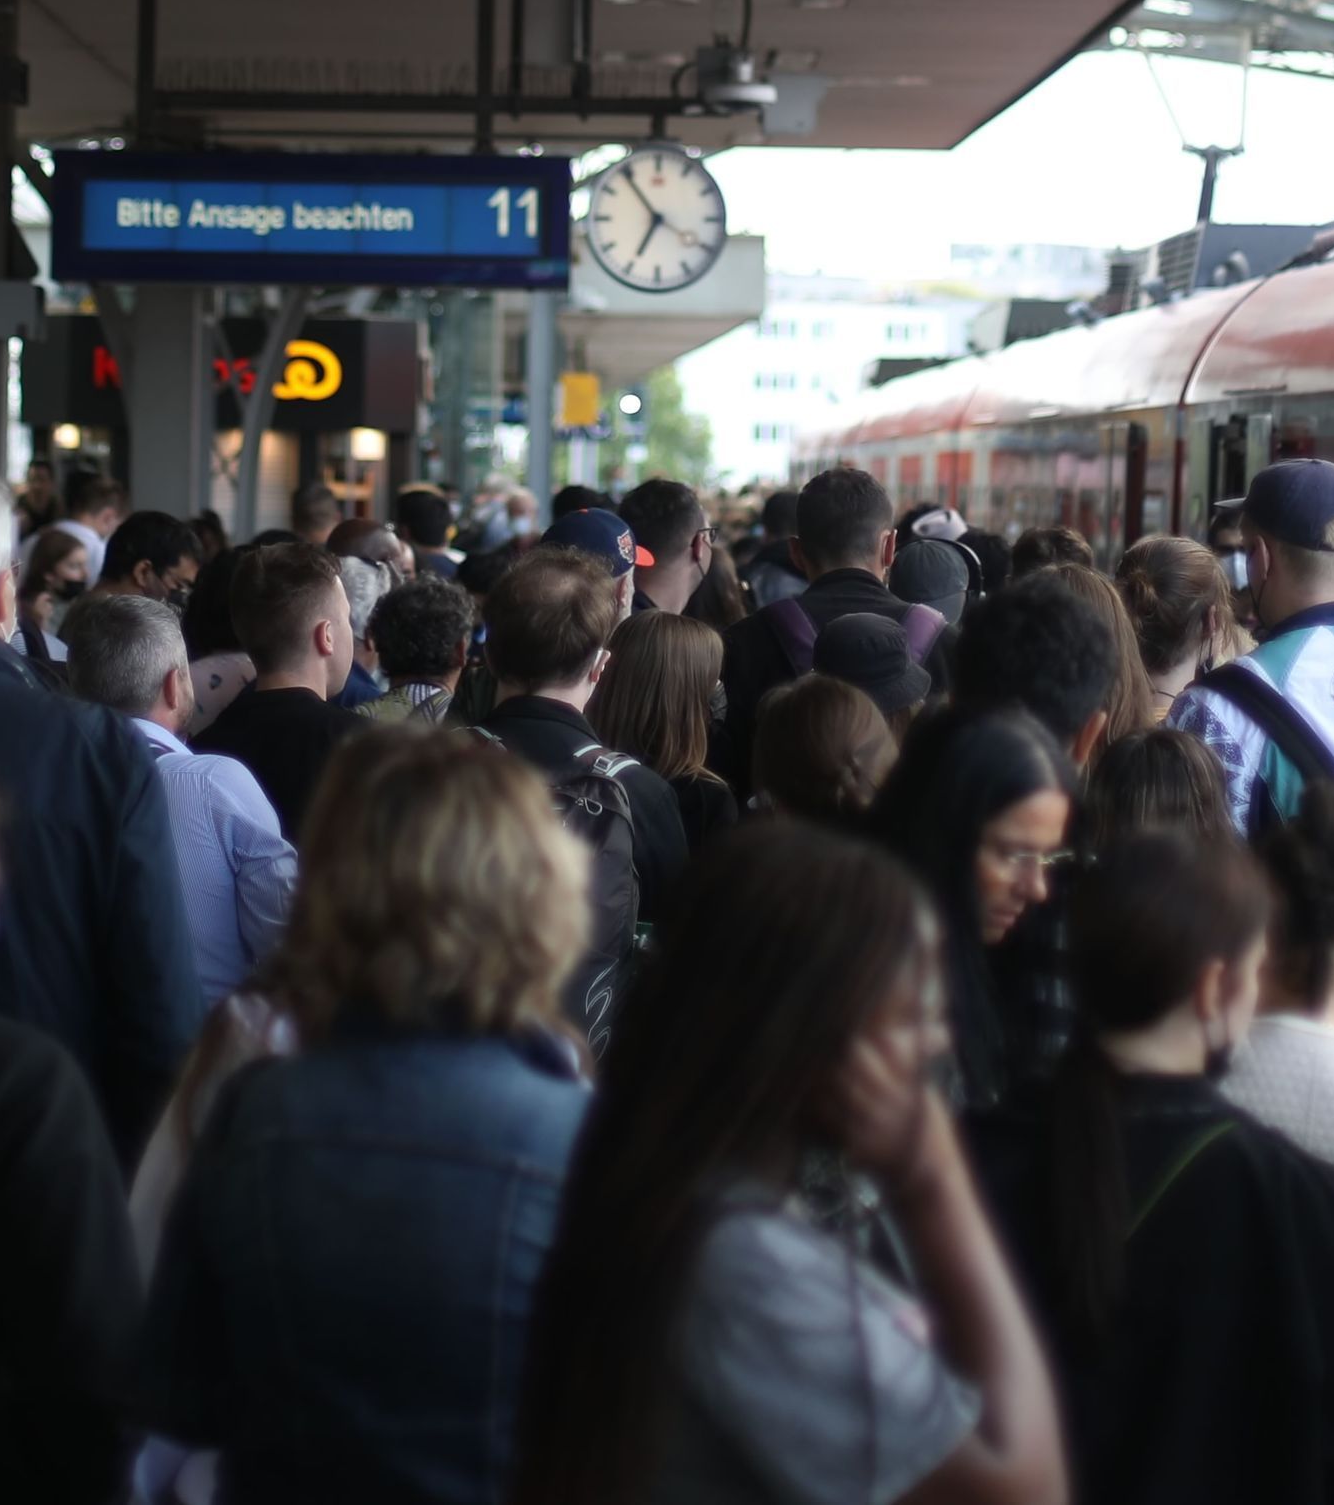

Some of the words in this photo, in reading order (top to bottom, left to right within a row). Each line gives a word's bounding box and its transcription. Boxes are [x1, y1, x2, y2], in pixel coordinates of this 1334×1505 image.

[115, 197, 180, 228] Bitte
[187, 200, 285, 235] Ansage
[292, 201, 414, 232] beachten
[486, 188, 540, 238] 11
